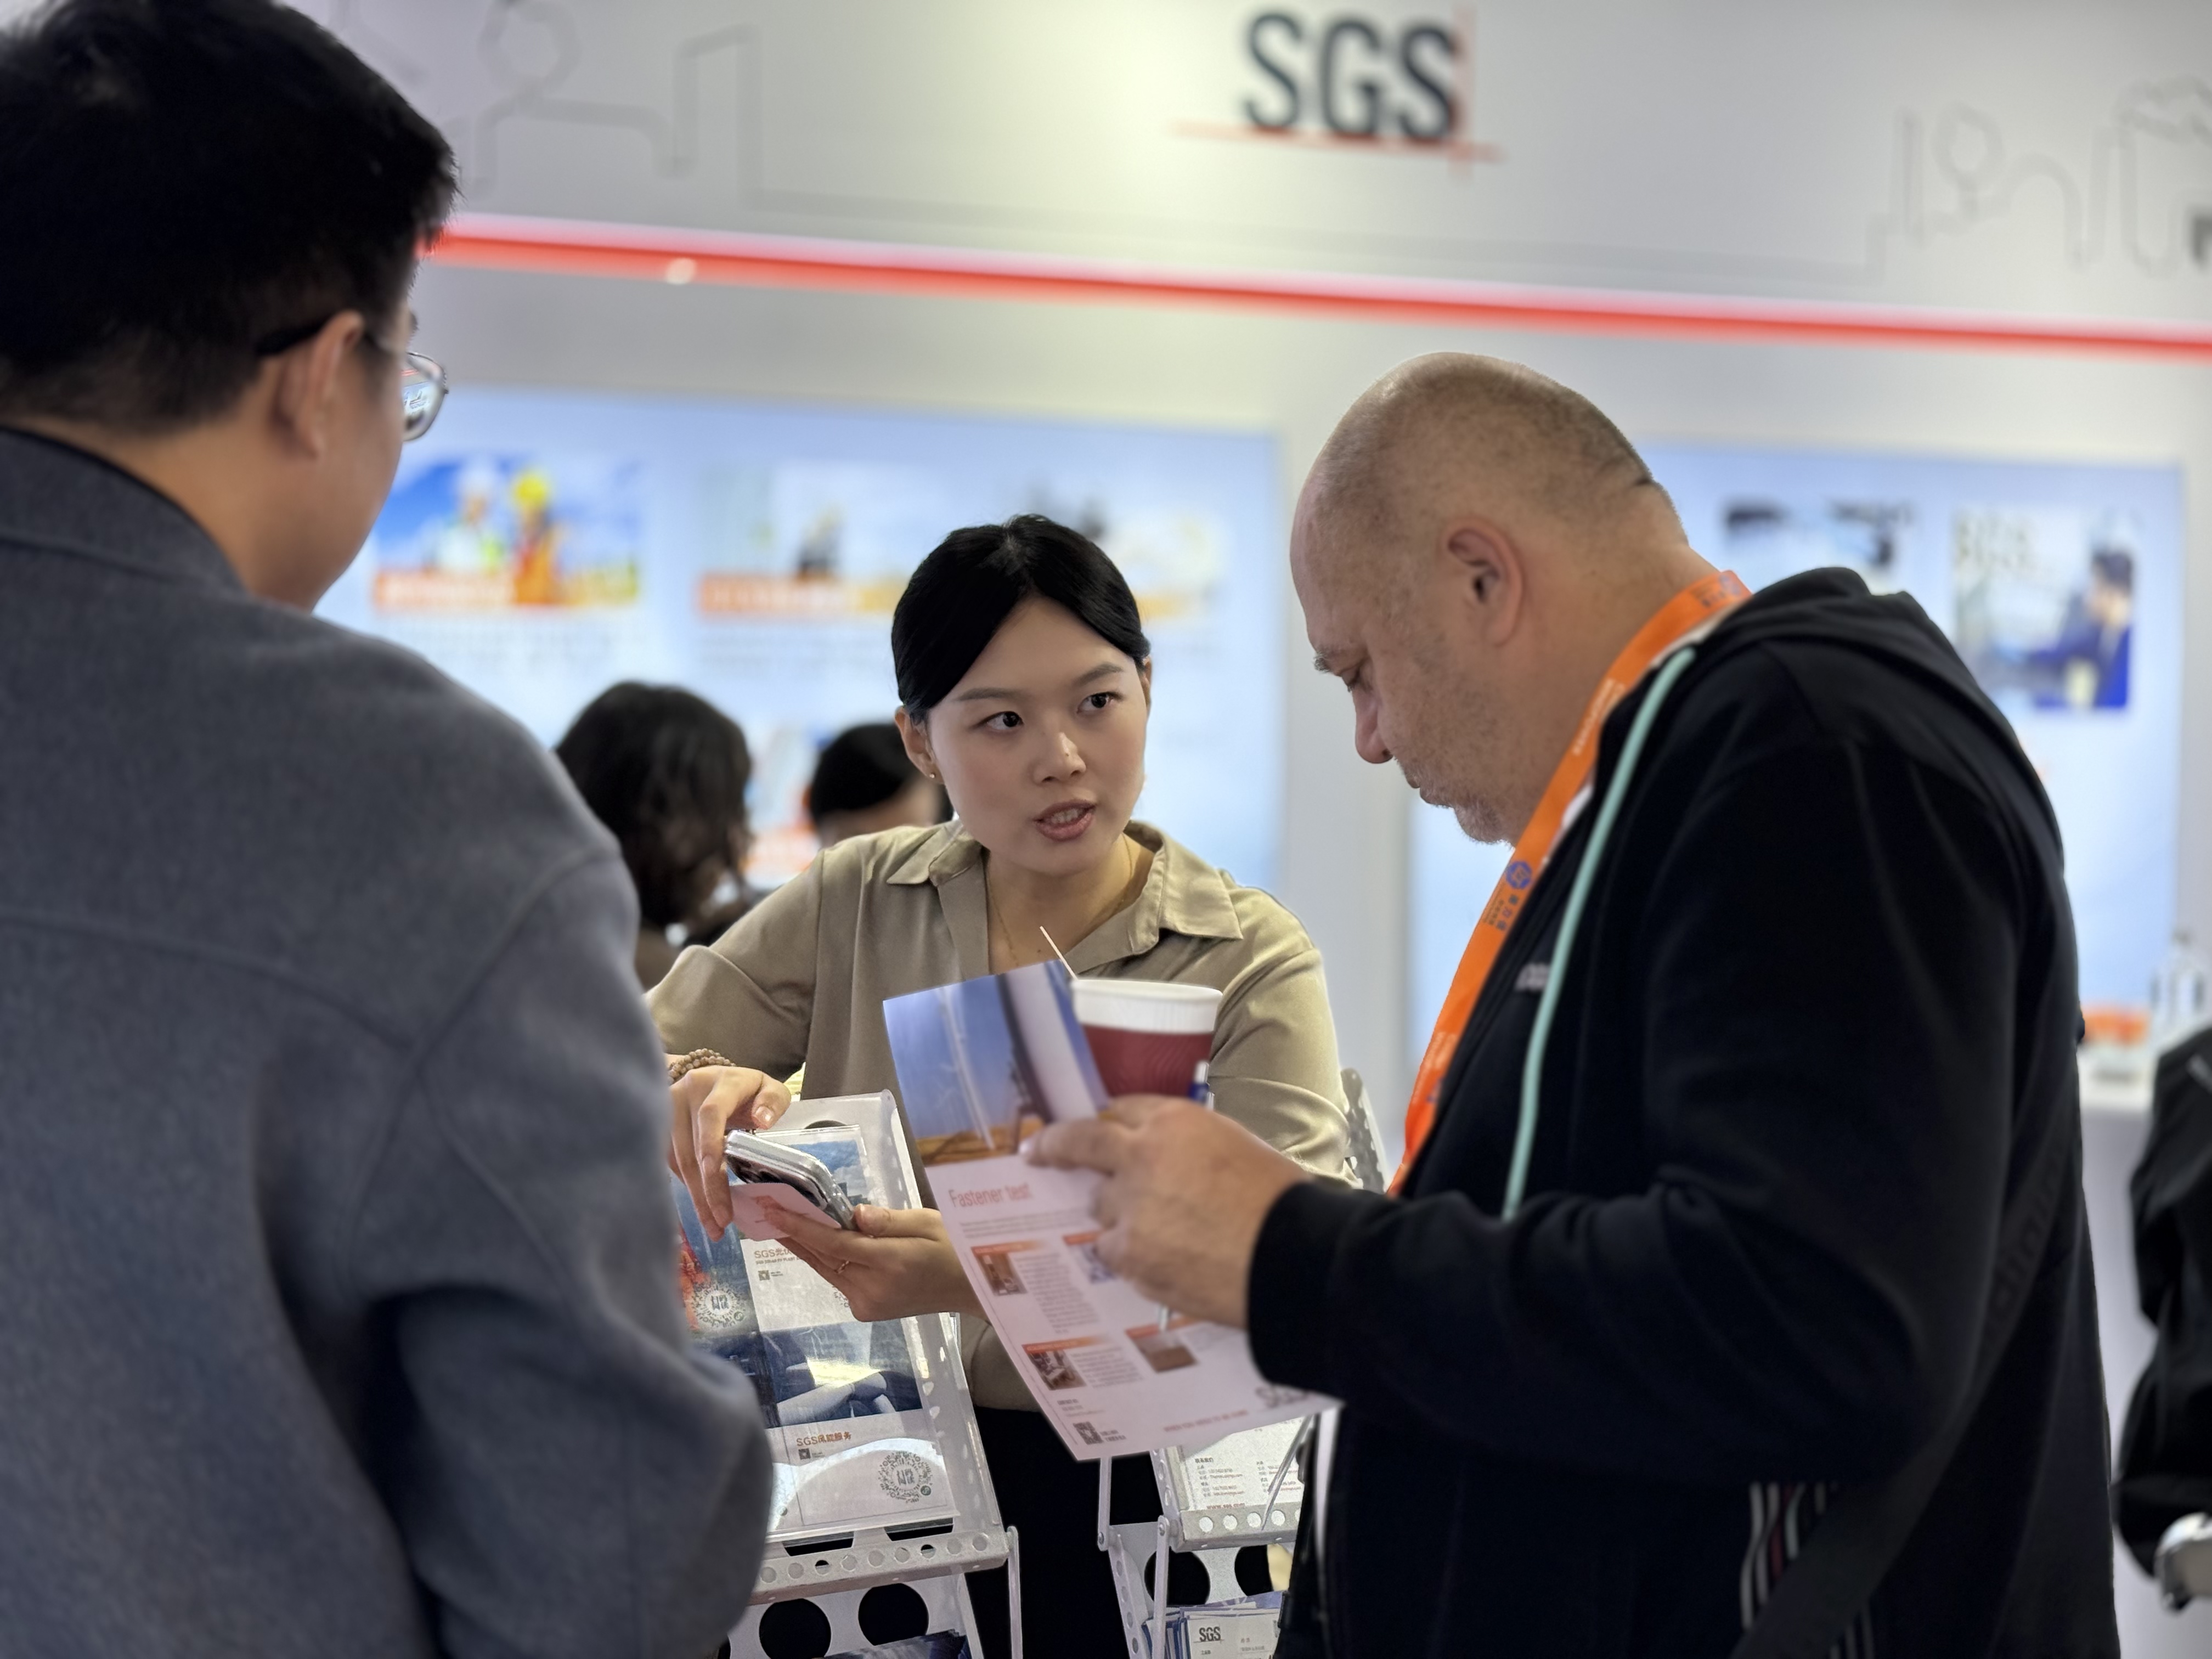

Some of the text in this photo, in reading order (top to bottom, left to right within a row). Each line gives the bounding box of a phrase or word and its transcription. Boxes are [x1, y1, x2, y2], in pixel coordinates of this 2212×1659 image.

[1243, 12, 1457, 143] SGS
[948, 1182, 1032, 1207] Fastener test
[1199, 1627, 1221, 1641] SGS
